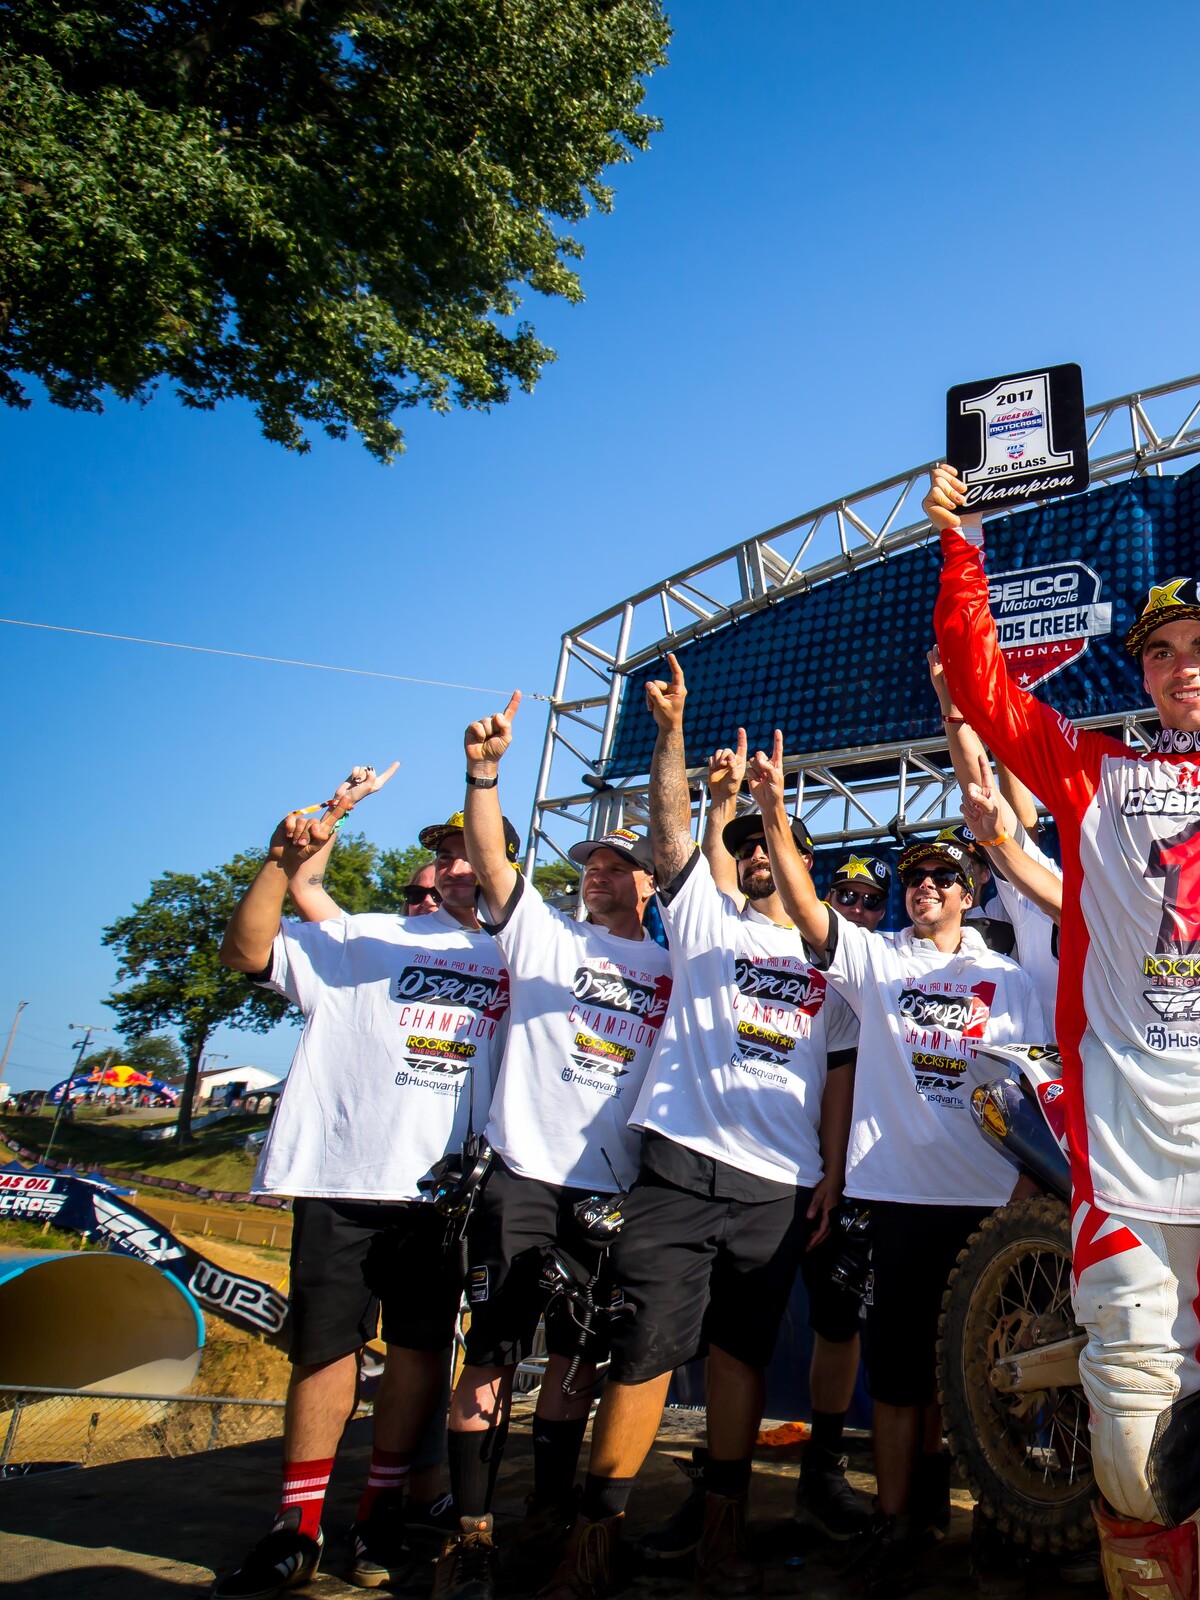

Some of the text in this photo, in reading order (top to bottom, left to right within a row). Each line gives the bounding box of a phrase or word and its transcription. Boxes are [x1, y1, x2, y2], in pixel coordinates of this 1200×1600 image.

[996, 389, 1034, 407] 2017
[989, 418, 1042, 433] MOTOCROSS
[996, 410, 1034, 423] LUCAS OIL
[987, 457, 1047, 476] 250 CLASS
[963, 475, 1075, 508] Champion
[1000, 591, 1079, 613] Motorcycle
[1030, 611, 1089, 639] CREEK
[1006, 643, 1072, 660] TIONAL
[413, 953, 495, 976] 2017 AMA PRO MX 250
[766, 957, 779, 968] PRO
[781, 958, 791, 968] MX
[640, 971, 652, 983] 250
[735, 963, 826, 1007] OSBORNE
[929, 982, 941, 993] PRO
[943, 982, 953, 993] MX
[955, 983, 968, 994] 250
[399, 969, 510, 1011] OSBORNE
[572, 970, 669, 1019] OSBORNE
[399, 1006, 497, 1041] CHAMPION
[899, 994, 990, 1031] OSBORNE
[568, 1004, 657, 1048] CHAMPION
[737, 1021, 797, 1049] ROCKSTAR
[406, 1035, 477, 1057] ROCKSTAR
[575, 1032, 637, 1062] ROCKSTAR
[739, 1063, 789, 1085] Husqvarna
[24, 1177, 51, 1191] OIL
[95, 1224, 156, 1266] RACING
[189, 1260, 289, 1334] WPS
